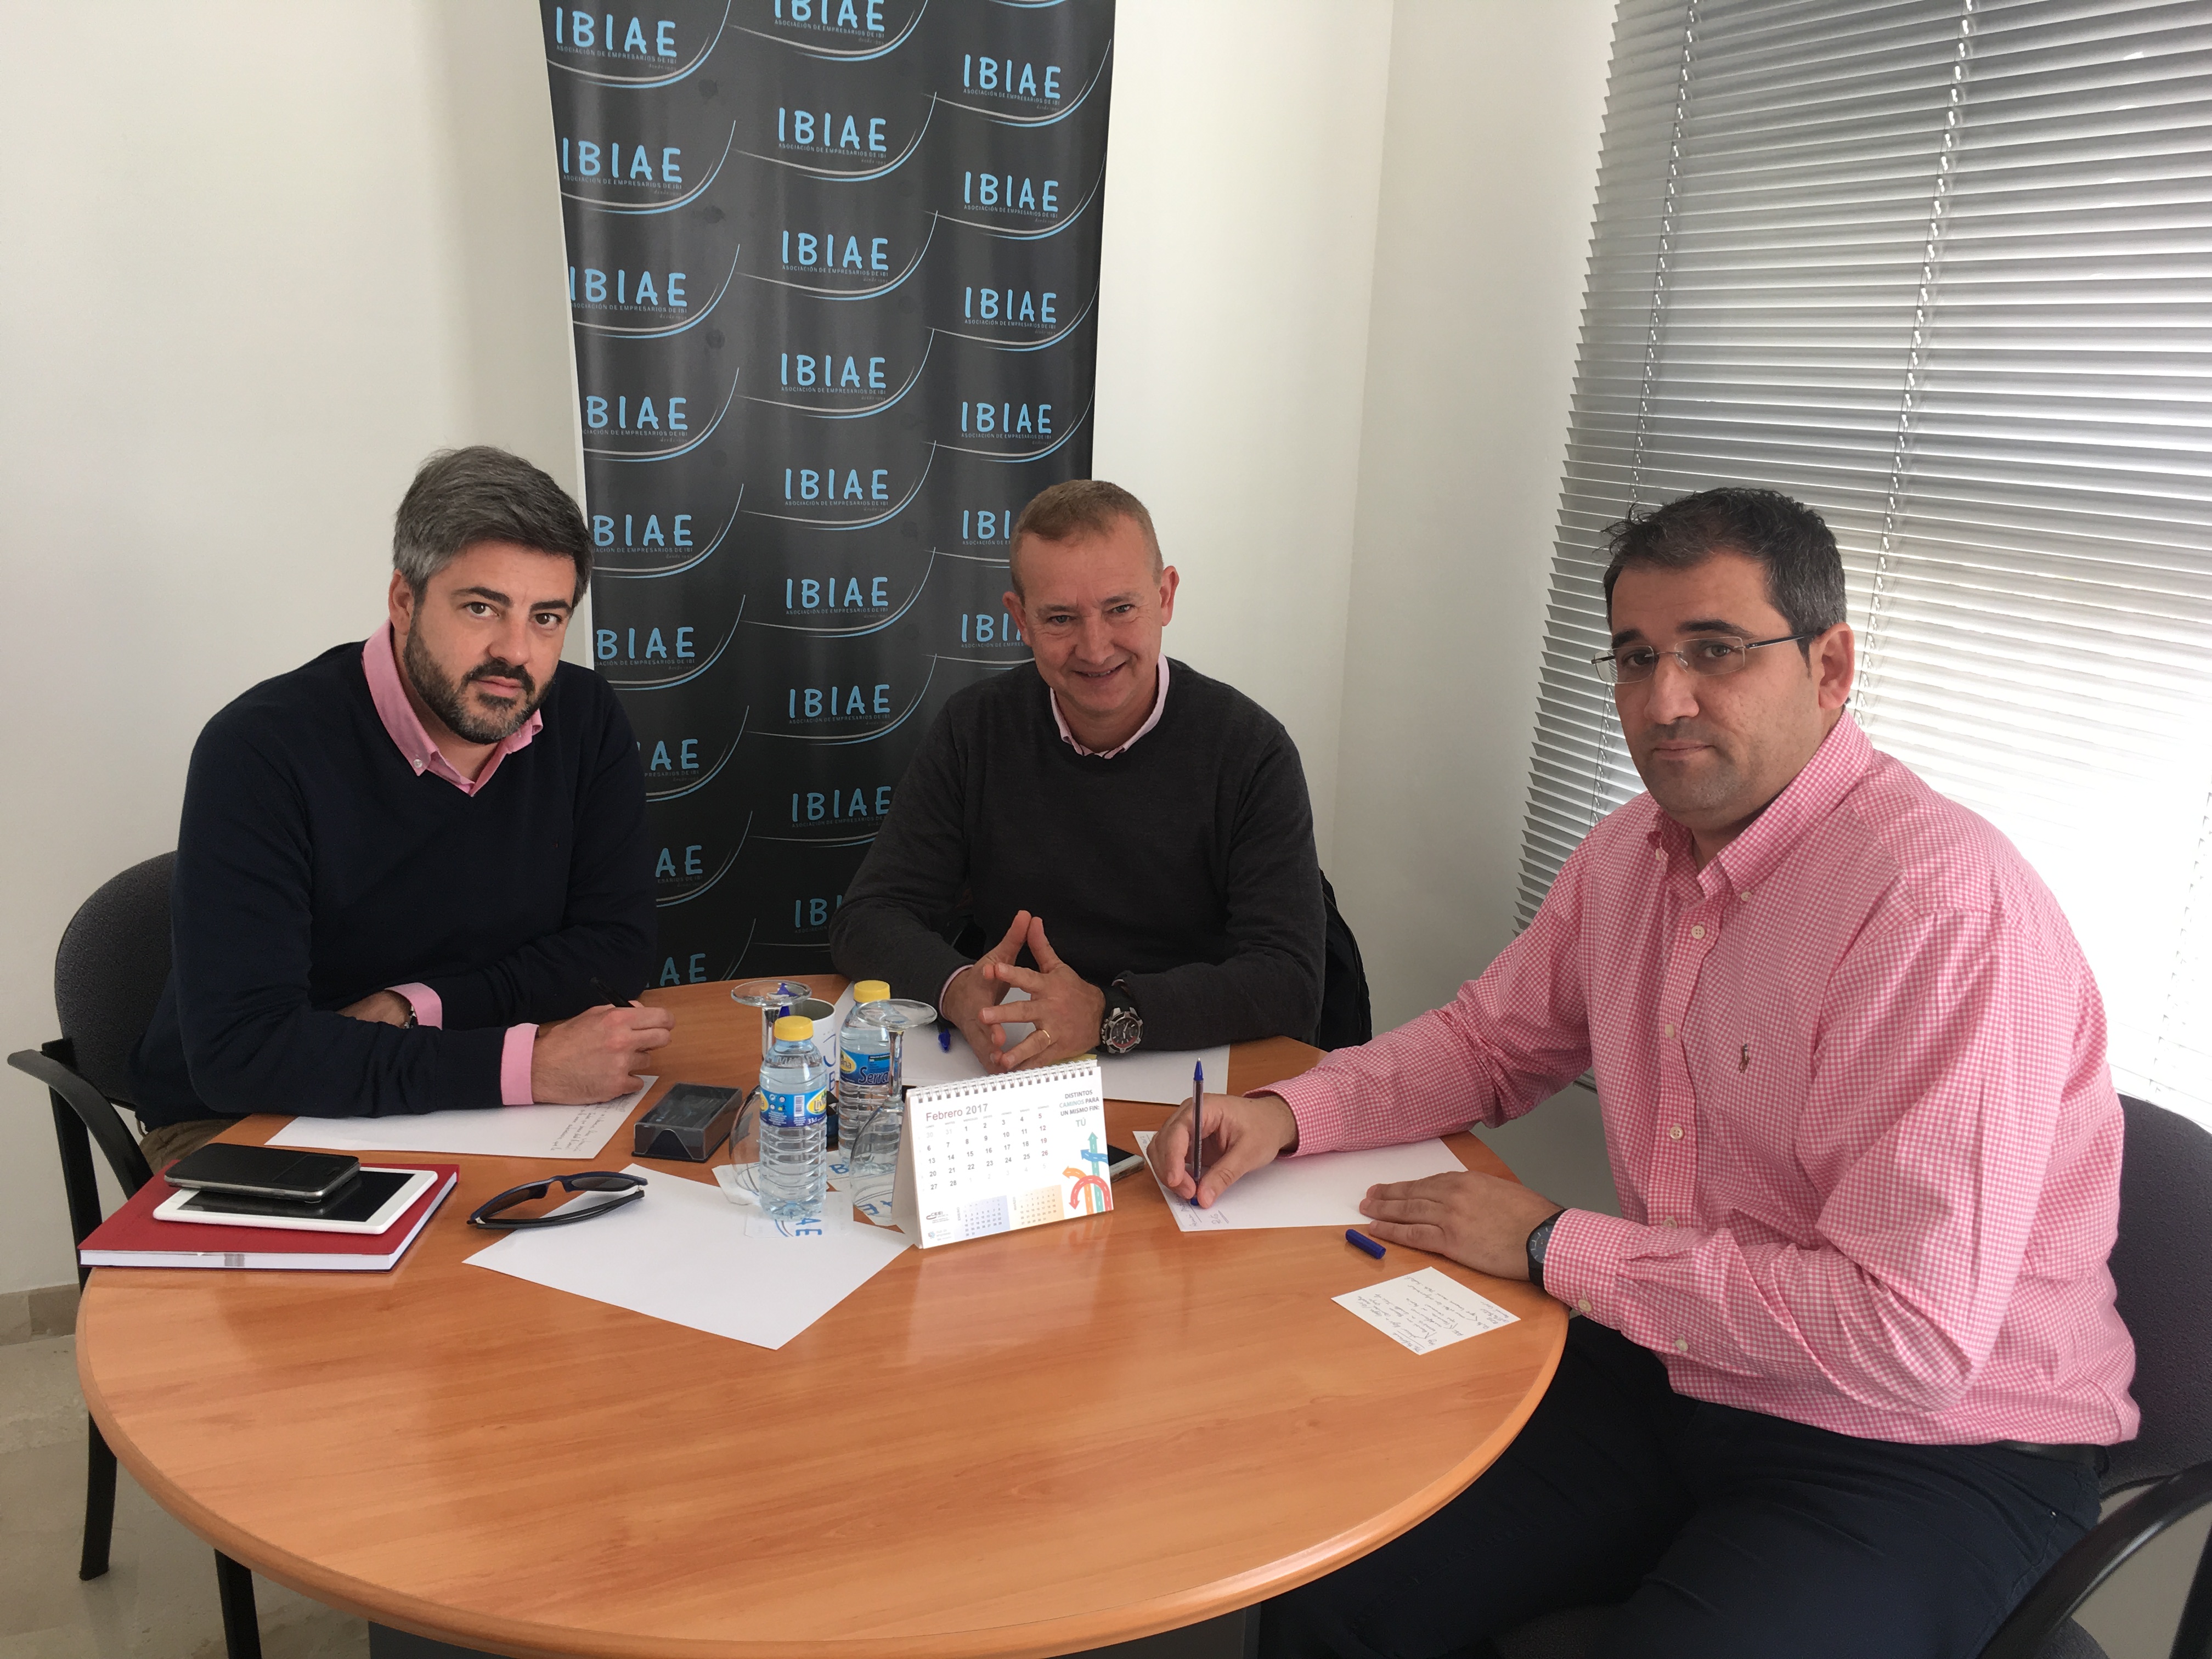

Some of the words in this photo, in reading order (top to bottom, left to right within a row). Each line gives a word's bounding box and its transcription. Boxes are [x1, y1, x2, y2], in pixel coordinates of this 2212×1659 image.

[556, 7, 677, 57] IBIAE
[774, 0, 885, 32] IBIAE
[963, 54, 1060, 99] IBIAE
[778, 107, 887, 152] IBIAE
[563, 137, 682, 183] IBIAE
[964, 171, 1058, 212] IBIAE
[782, 230, 889, 270] IBIAE
[570, 266, 687, 307] IBIAE
[964, 287, 1057, 324] IBIAE
[781, 353, 886, 389] IBIAE
[586, 396, 688, 430] BIAE
[961, 402, 1052, 434] IBIAE
[785, 469, 889, 500] IBIAE
[593, 515, 693, 547] BIAE
[963, 510, 1011, 539] IBI
[786, 577, 888, 609] IBIAE
[596, 627, 695, 660] BIAE
[961, 613, 1009, 642] IBI
[790, 684, 890, 718] IBIAE
[792, 786, 891, 822] IBIAE
[1059, 1099, 1084, 1108] CAMINOS
[1065, 1090, 1092, 1099] DISTINTOS
[926, 1109, 963, 1121] Febrero
[966, 1103, 988, 1115] 2017
[1075, 1117, 1086, 1127] TÚ
